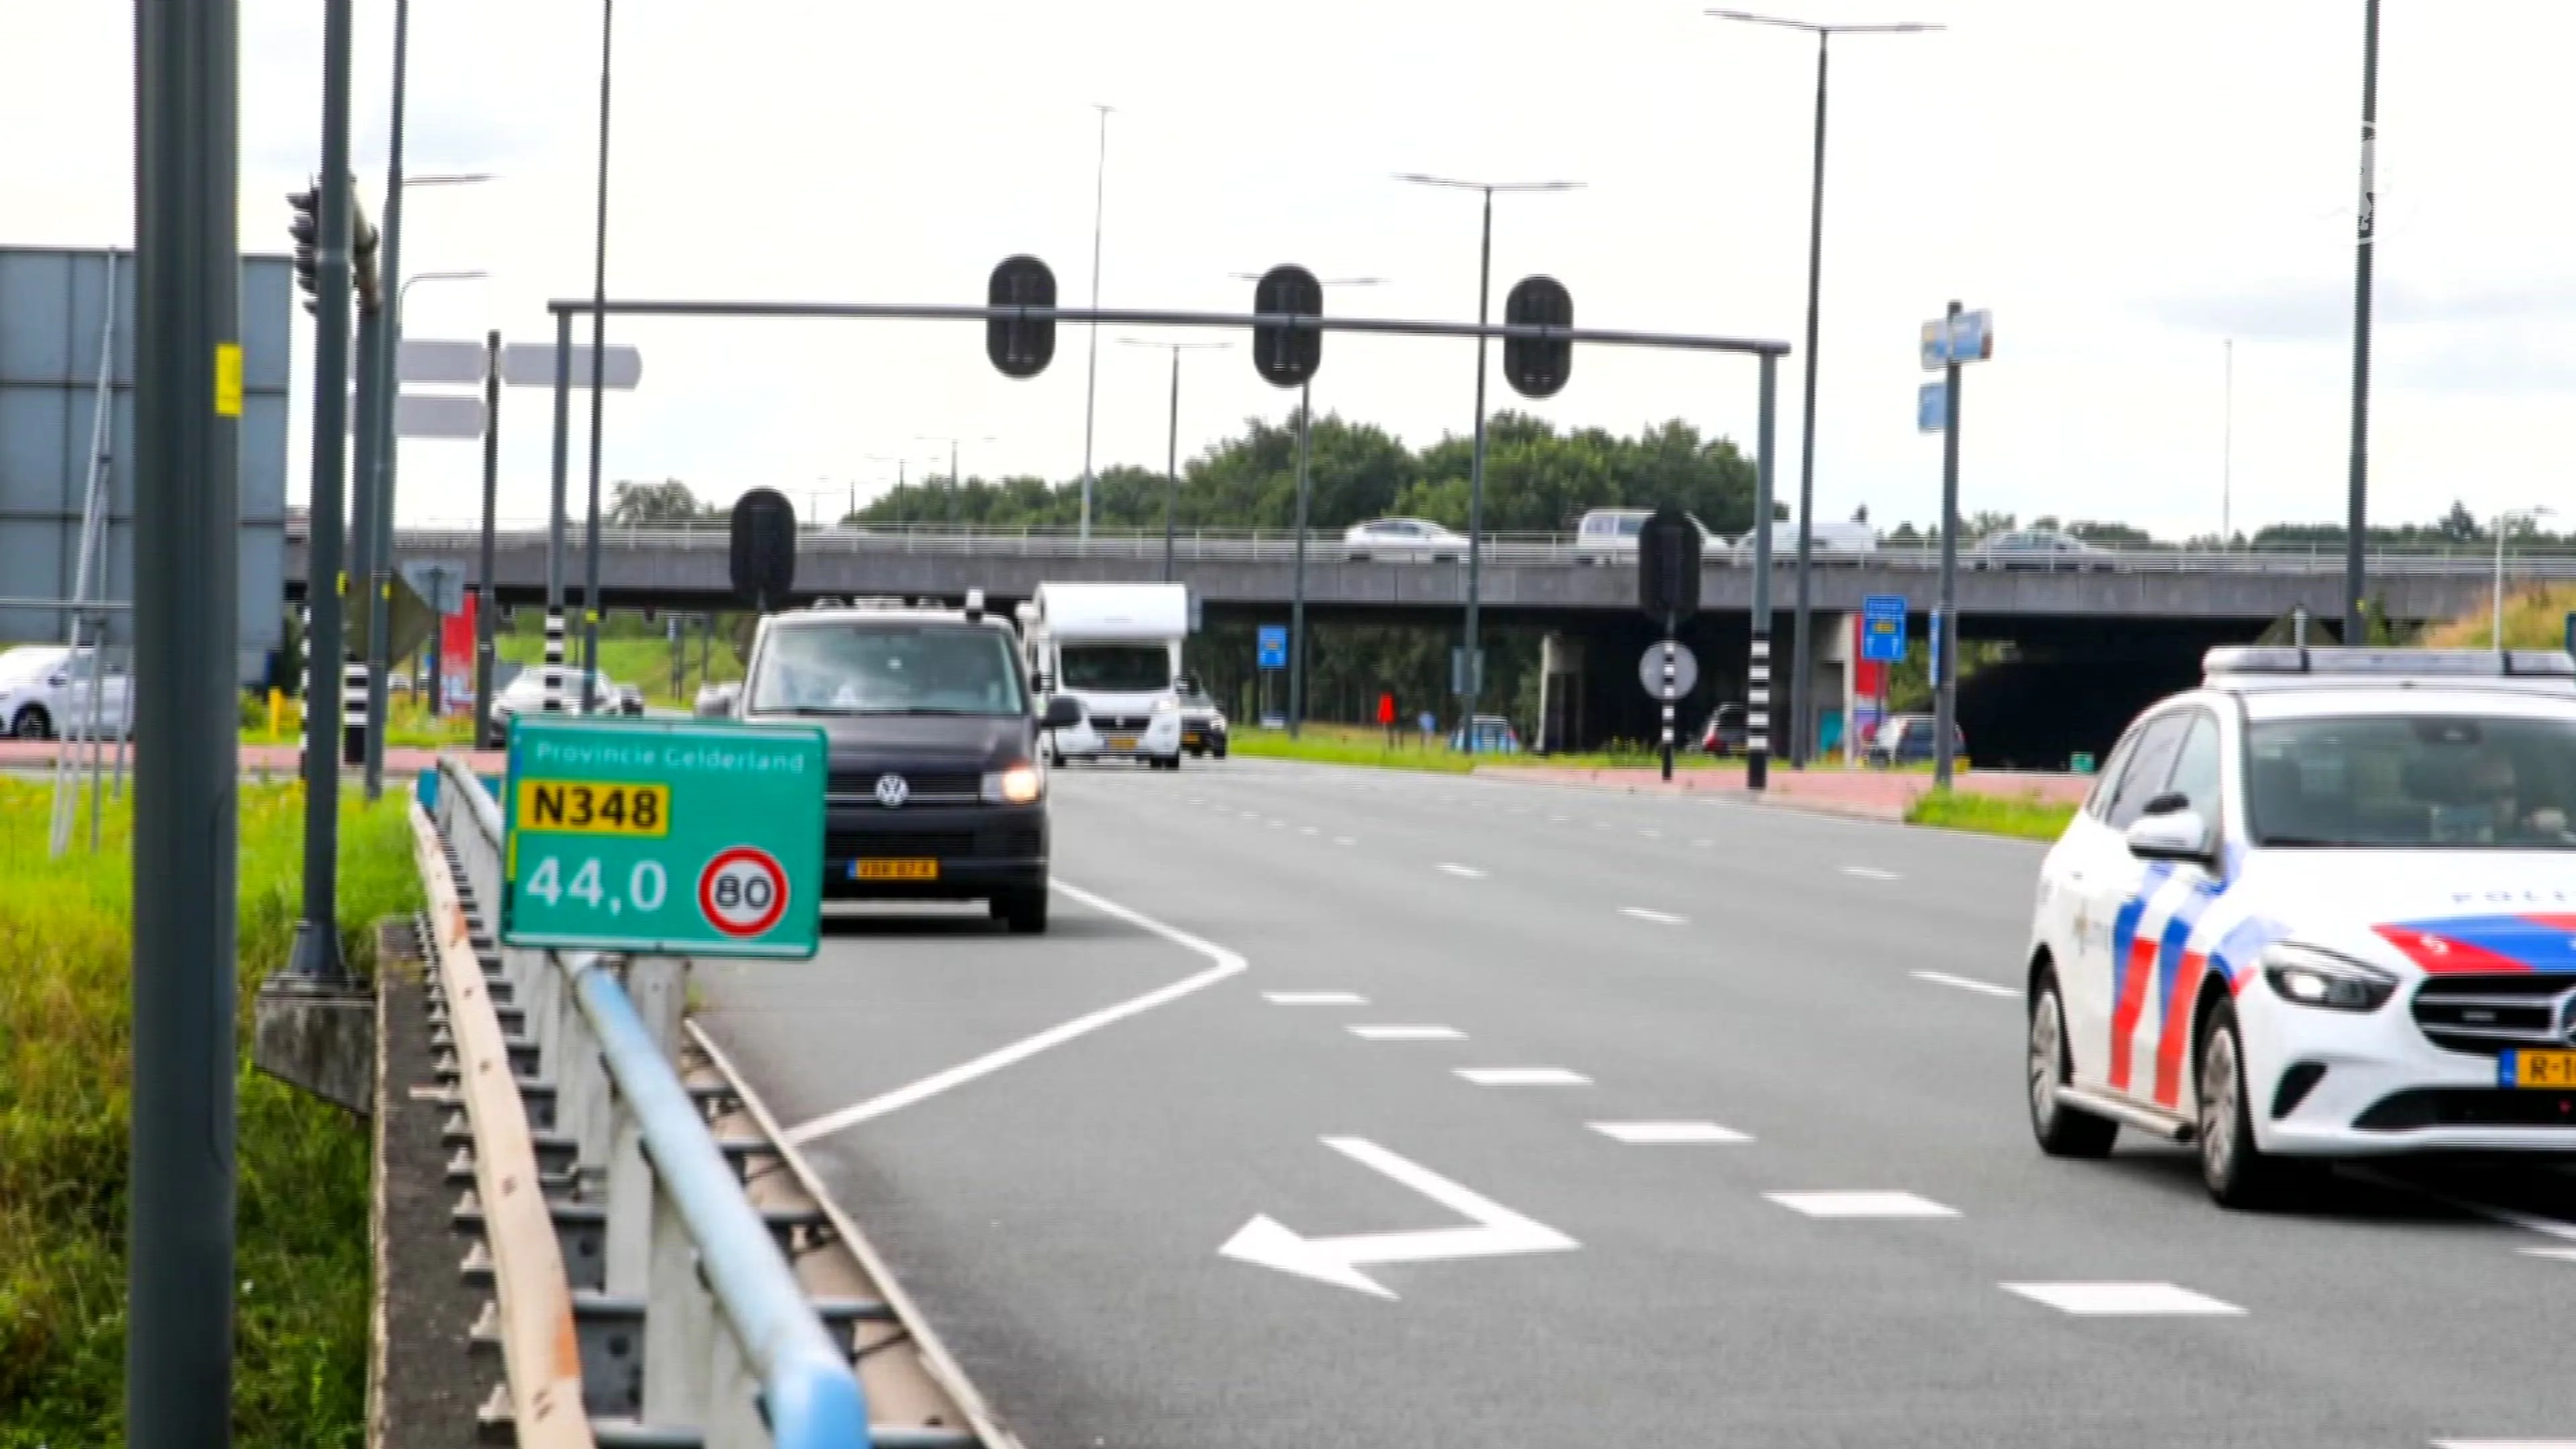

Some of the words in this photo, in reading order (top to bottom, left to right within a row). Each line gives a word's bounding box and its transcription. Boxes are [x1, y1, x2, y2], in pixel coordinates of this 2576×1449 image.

[537, 741, 655, 765] Provincie
[665, 745, 804, 773] Gelderland
[535, 785, 659, 829] N348
[527, 856, 667, 916] 44,0
[716, 875, 773, 910] 80
[2450, 890, 2576, 904] POLI
